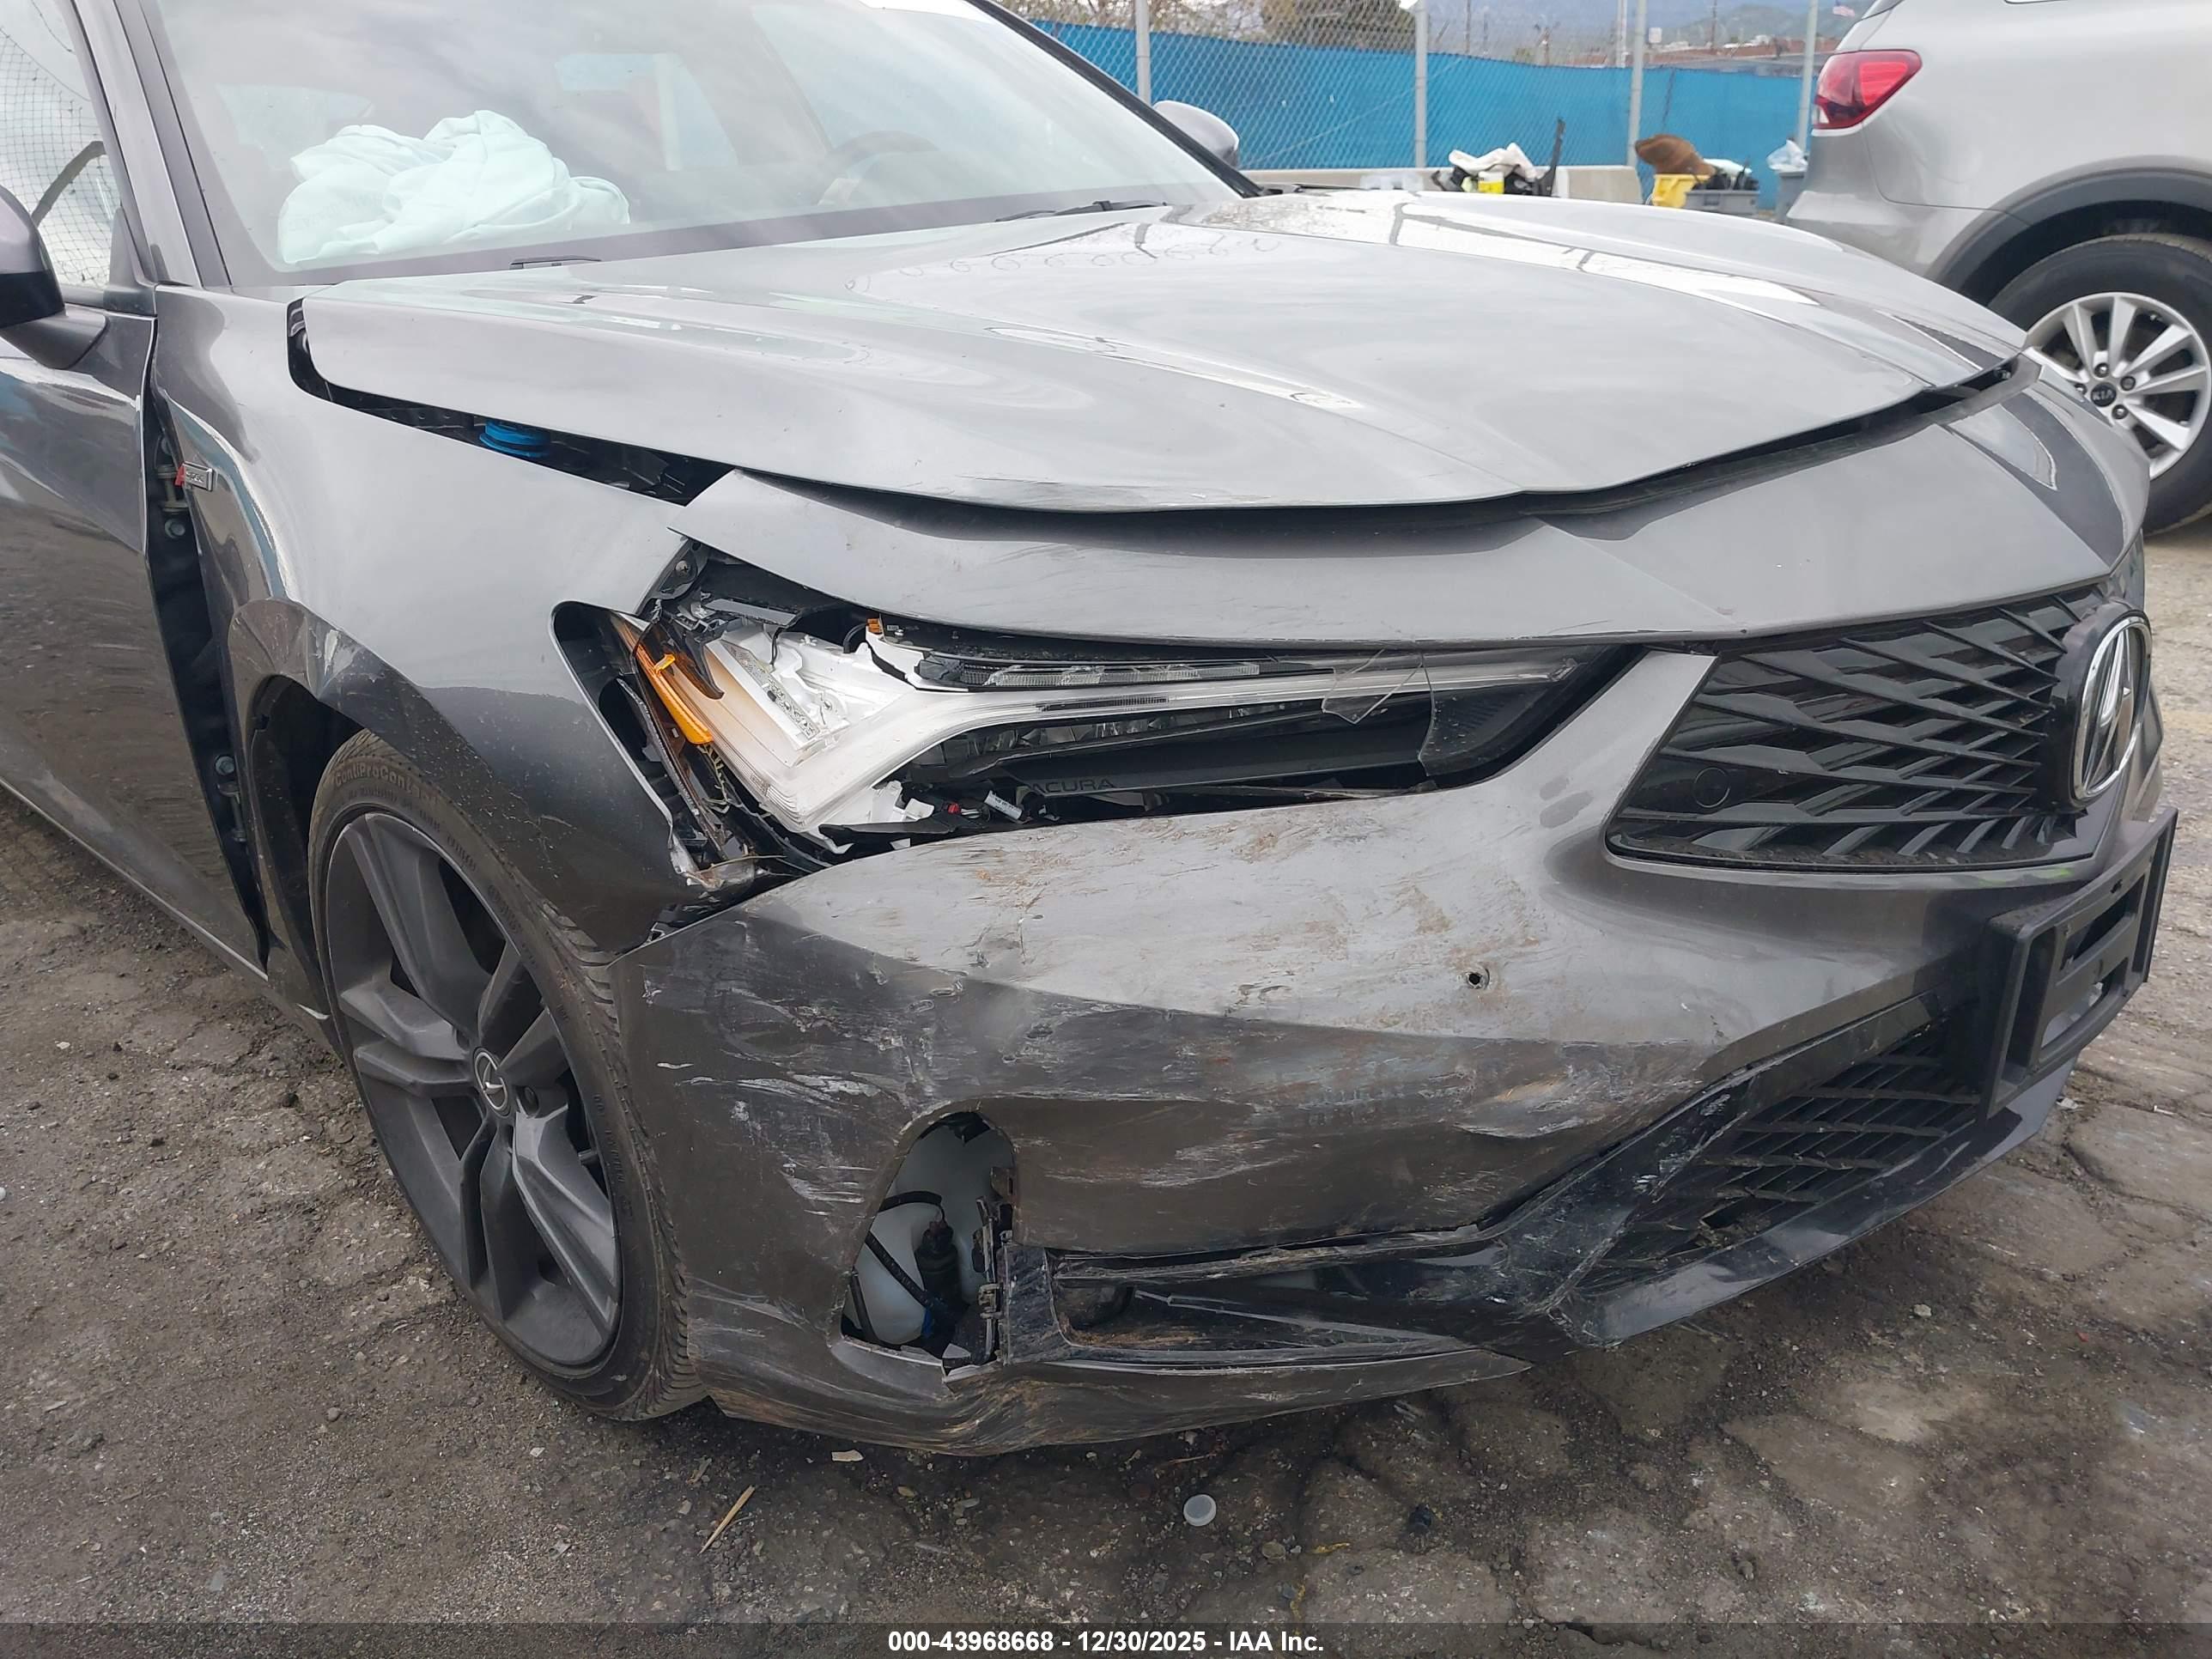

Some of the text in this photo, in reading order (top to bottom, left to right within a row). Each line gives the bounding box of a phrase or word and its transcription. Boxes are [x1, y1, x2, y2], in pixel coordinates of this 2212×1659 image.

[2092, 388, 2115, 401] KIA
[333, 761, 442, 805] ContiProConta
[1032, 778, 1116, 793] ACURA
